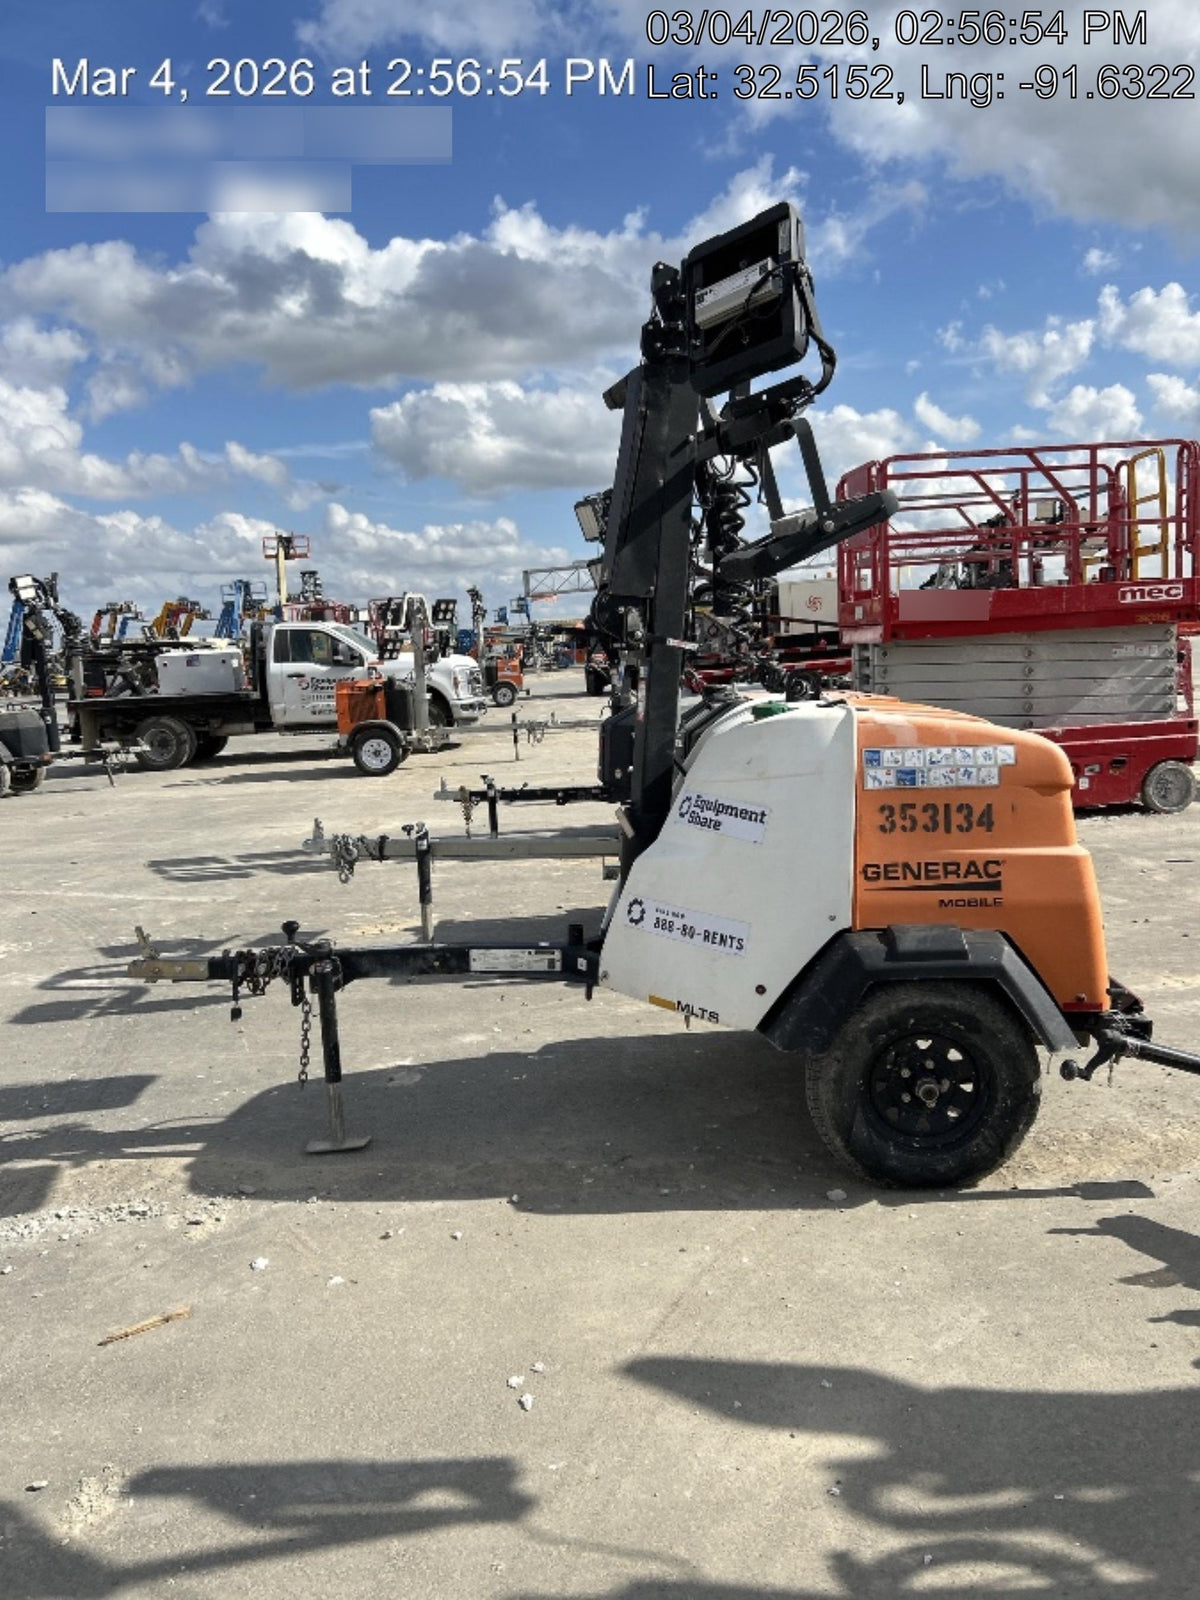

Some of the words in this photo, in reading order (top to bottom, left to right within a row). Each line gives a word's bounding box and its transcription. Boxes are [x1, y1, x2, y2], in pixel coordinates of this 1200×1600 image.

[1119, 586, 1182, 601] mec
[693, 794, 767, 824] Equipment
[878, 803, 995, 834] 353134
[687, 810, 722, 831] Share
[862, 860, 1002, 882] GENERAC
[938, 898, 1003, 908] MOBILE
[653, 917, 744, 951] 888-80-RENTS
